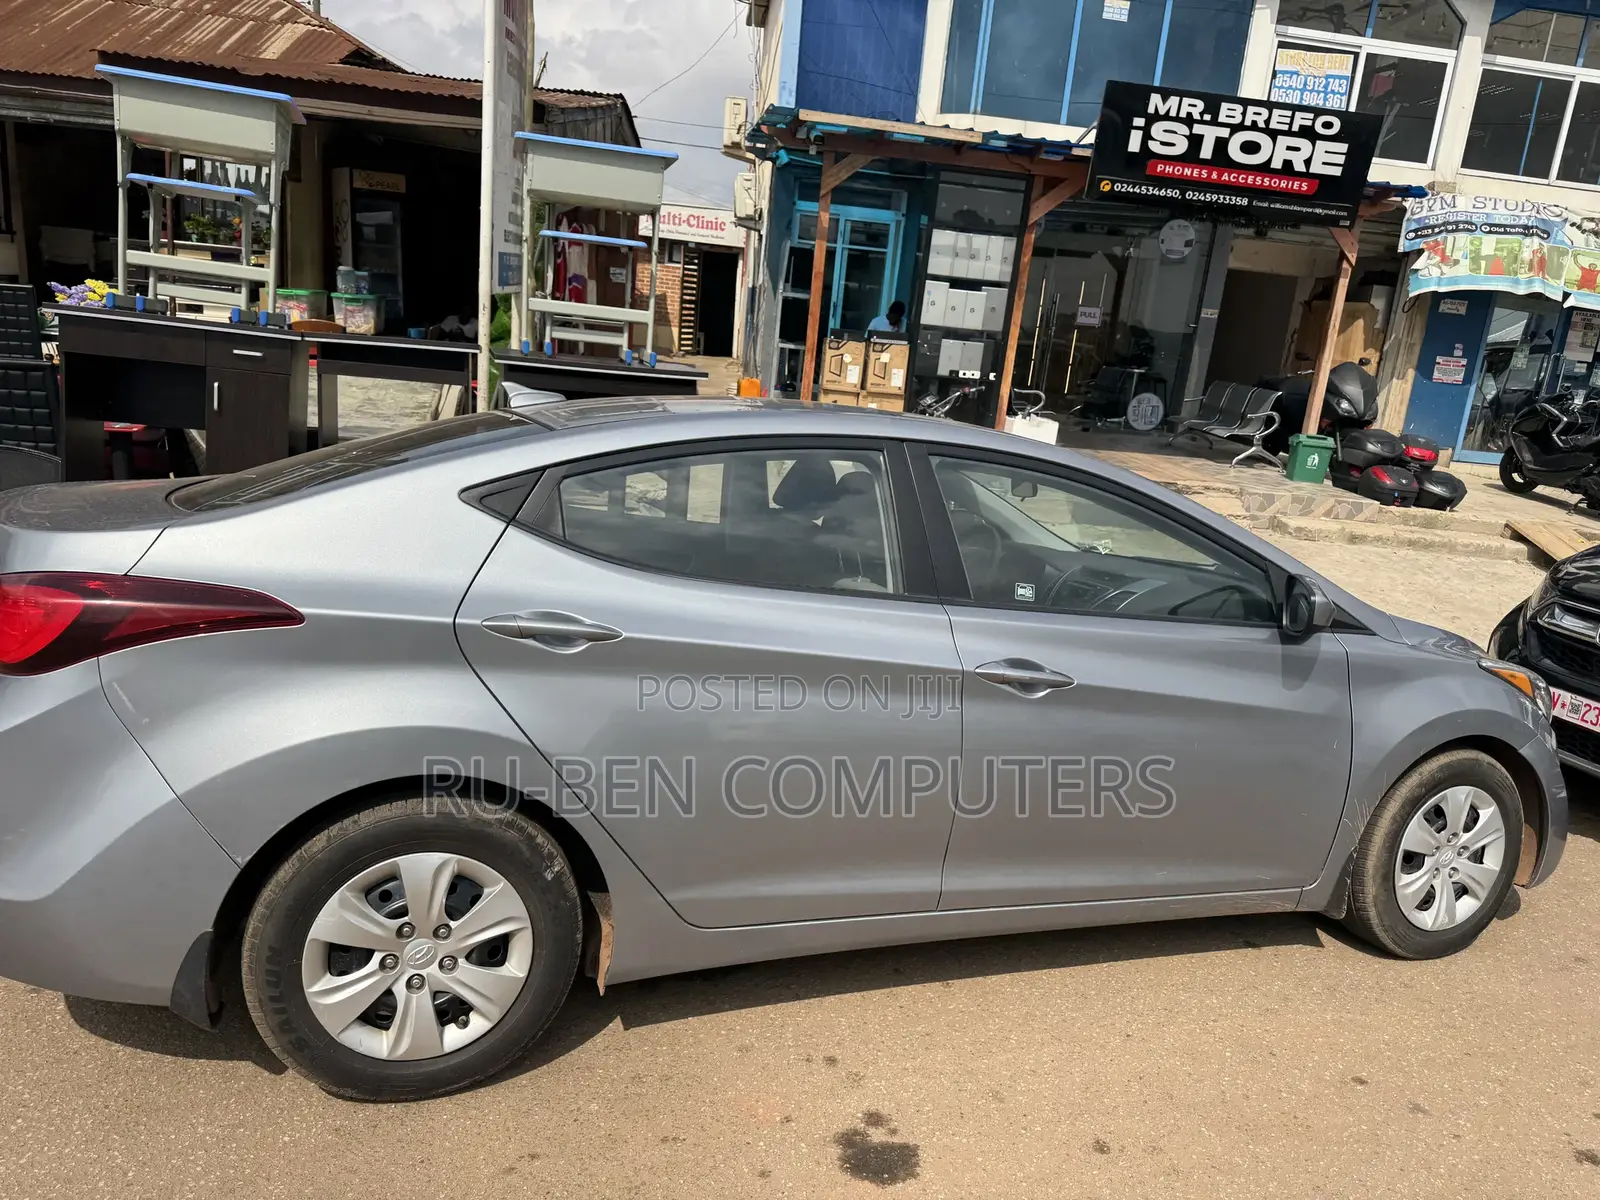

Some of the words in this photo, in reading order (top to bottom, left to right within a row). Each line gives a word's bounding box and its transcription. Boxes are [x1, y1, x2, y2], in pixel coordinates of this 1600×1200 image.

[1275, 74, 1304, 89] 0540
[1306, 77, 1326, 91] 912
[1328, 78, 1347, 93] 743
[1271, 88, 1301, 104] 0530
[1302, 91, 1324, 106] 904
[1326, 93, 1347, 108] 361
[1147, 93, 1211, 121] MR.
[1218, 102, 1341, 136] BREFO
[1127, 117, 1349, 176] iSTORE
[1156, 163, 1208, 179] PHONES
[1211, 170, 1218, 179] &
[1221, 172, 1309, 191] ACCESSORIES
[1113, 182, 1182, 199] 0244534650,
[1185, 191, 1249, 206] 0245933358
[1411, 195, 1457, 216] GYM
[1080, 311, 1097, 319] PULL
